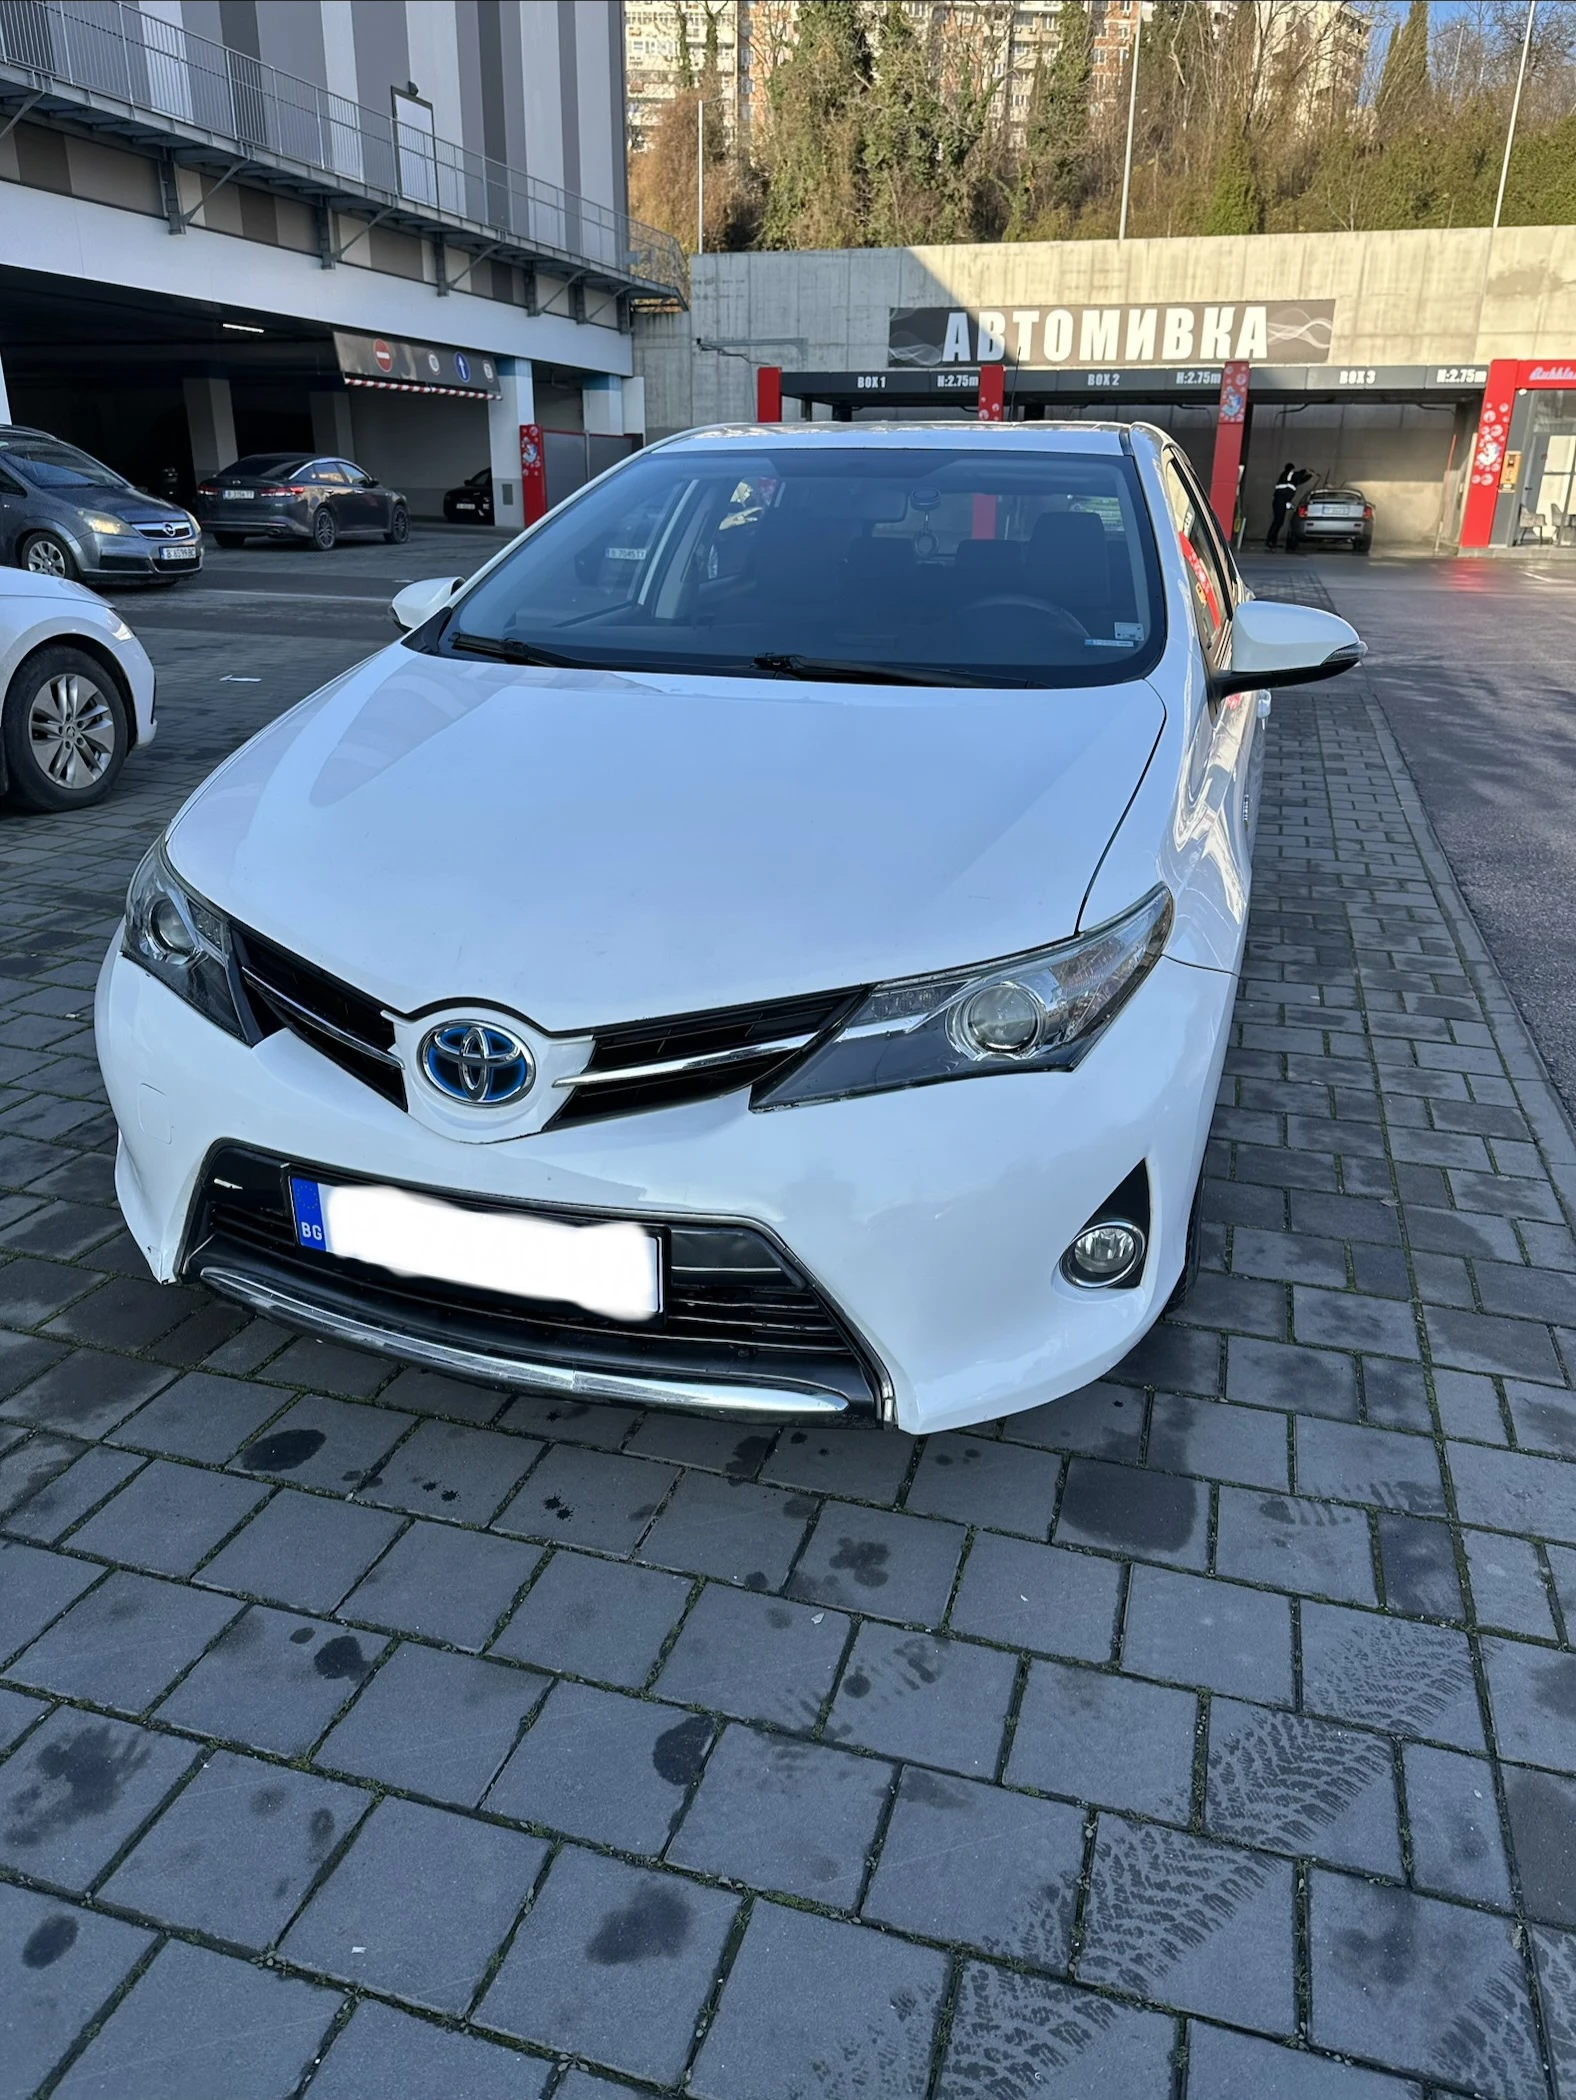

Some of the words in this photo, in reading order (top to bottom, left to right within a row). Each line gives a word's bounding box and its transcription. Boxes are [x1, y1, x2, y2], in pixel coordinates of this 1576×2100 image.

[942, 306, 1268, 362] АВТОМИВКА
[1087, 373, 1111, 386] BOX
[1112, 373, 1121, 386] 2
[1176, 371, 1222, 385] H:2.75m
[1339, 370, 1366, 385] BOX
[1366, 370, 1376, 385] 3
[1436, 368, 1487, 383] H:2.75m
[1528, 365, 1576, 381] Bubble
[857, 376, 879, 389] BOX
[880, 376, 886, 388] 1
[937, 374, 979, 388] H:2.75m
[301, 1221, 323, 1241] BG
